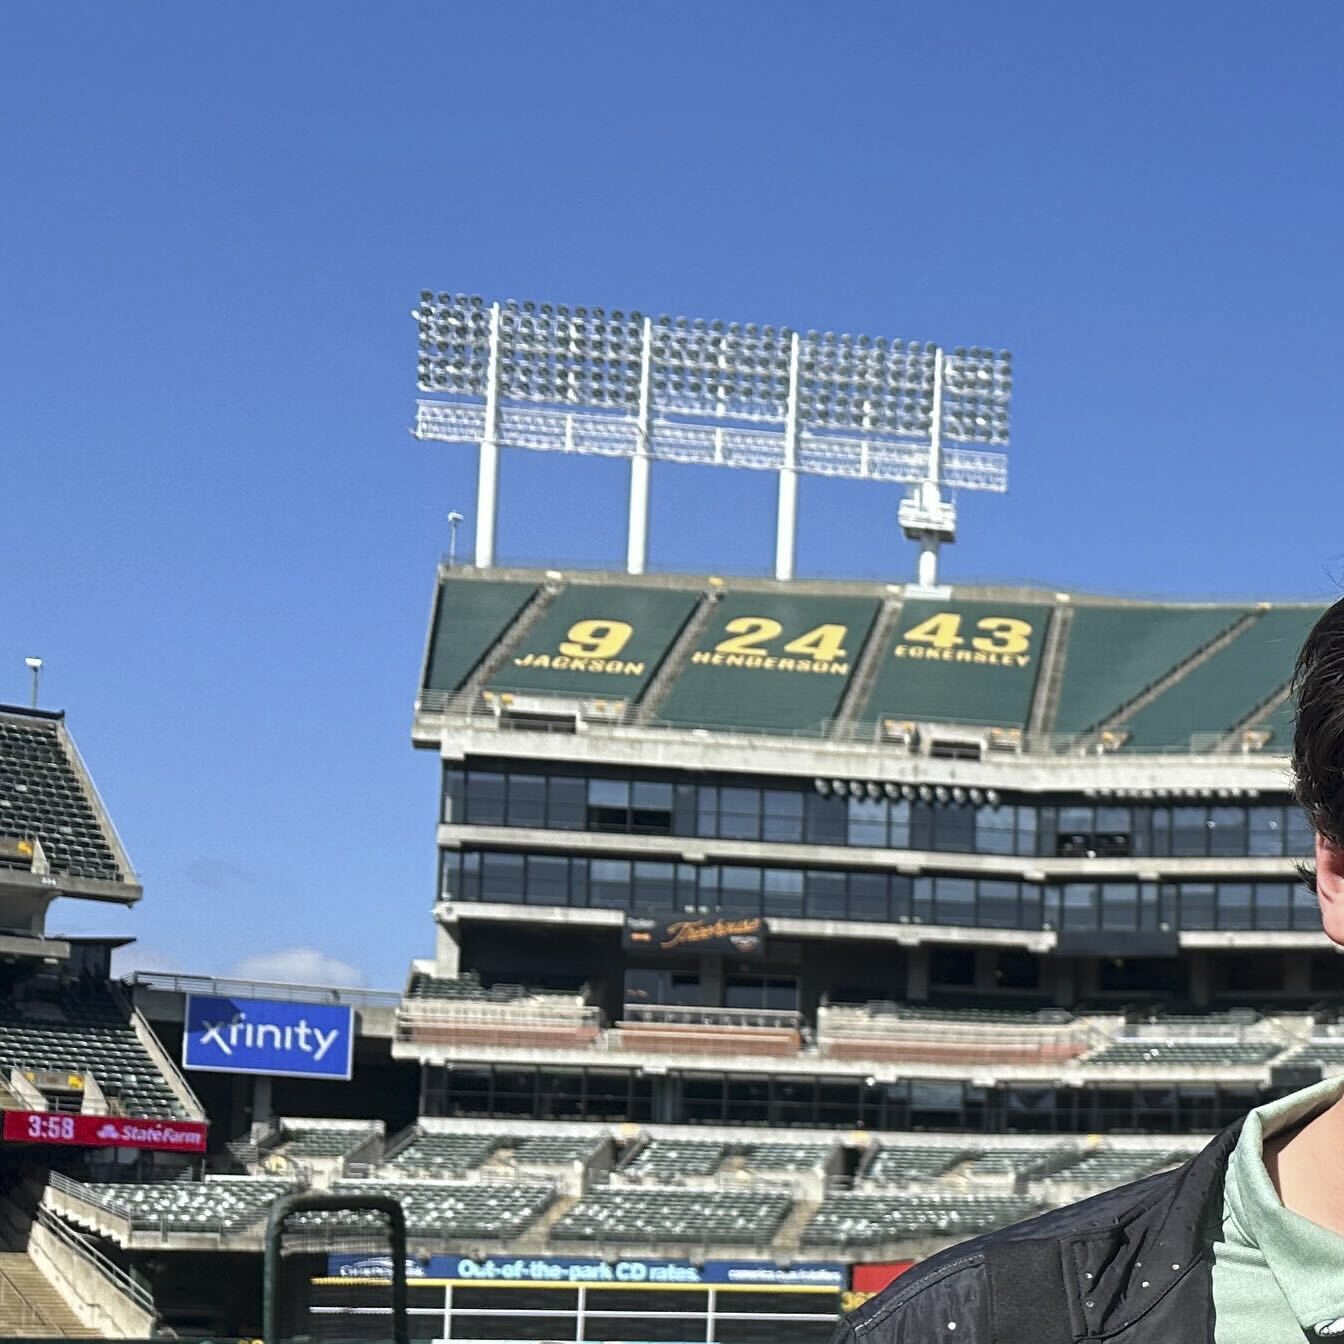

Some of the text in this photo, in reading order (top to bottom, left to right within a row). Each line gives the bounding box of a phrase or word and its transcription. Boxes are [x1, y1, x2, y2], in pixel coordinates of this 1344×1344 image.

[558, 618, 634, 659] 9
[714, 615, 848, 662] 24
[903, 612, 1034, 654] 43
[514, 652, 646, 676] JACKSON
[691, 651, 850, 676] HENDERSON
[894, 644, 1032, 668] ECKERSLEY
[199, 1012, 340, 1062] xfinity
[27, 1114, 75, 1140] 3:58
[457, 1259, 614, 1281] Out-of-the-park
[615, 1262, 647, 1281] CD
